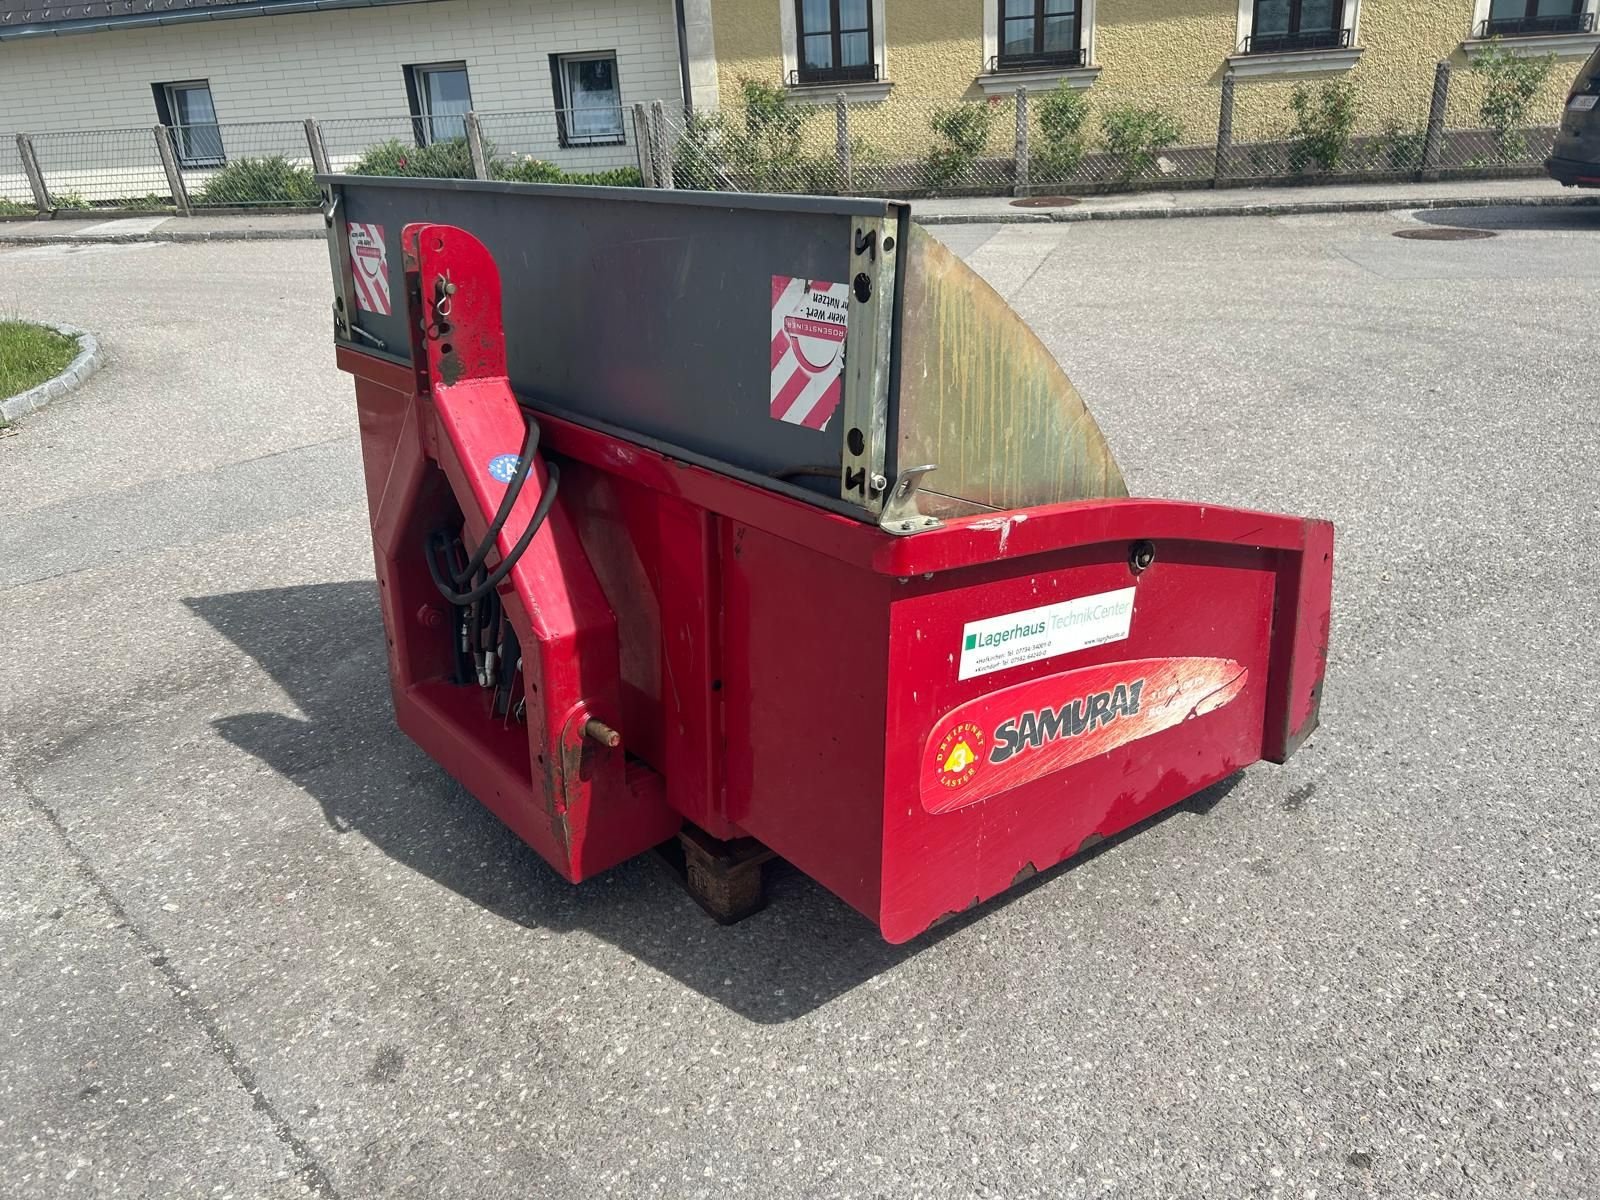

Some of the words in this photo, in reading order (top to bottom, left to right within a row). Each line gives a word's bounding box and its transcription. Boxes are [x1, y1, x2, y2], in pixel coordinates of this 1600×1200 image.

[813, 292, 840, 309] Nutzen
[806, 307, 826, 320] Wert
[827, 312, 846, 324] Mehr
[787, 322, 844, 337] ROSENSTEINER
[978, 621, 1046, 648] Lagerhaus
[1051, 602, 1130, 630] TechnikCenter
[989, 678, 1145, 763] SAMURAI
[936, 722, 985, 762] DREIPUNKT
[952, 749, 967, 773] 3
[940, 767, 977, 787] LASTER
